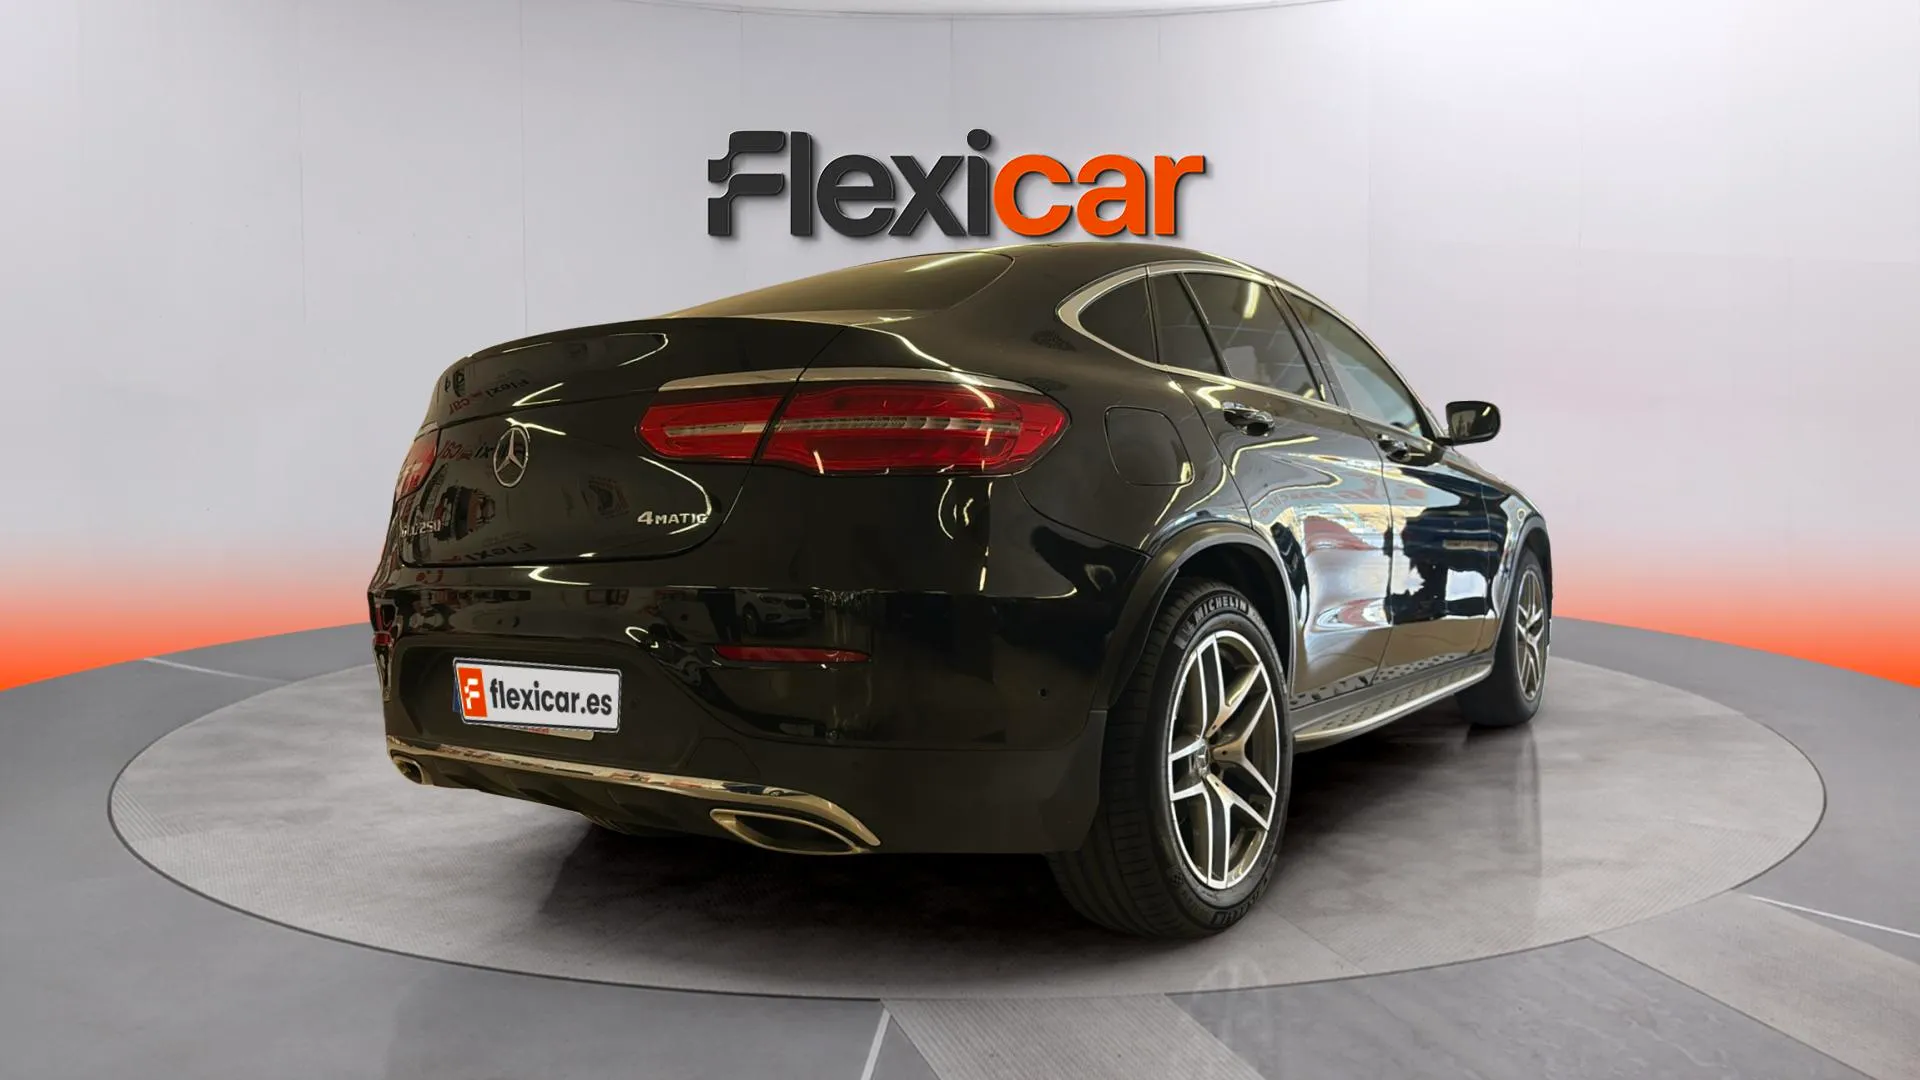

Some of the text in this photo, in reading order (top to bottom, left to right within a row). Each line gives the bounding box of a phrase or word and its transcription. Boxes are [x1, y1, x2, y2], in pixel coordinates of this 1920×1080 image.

[707, 128, 1206, 237] Flexicar
[637, 511, 708, 525] 4MATIC
[1194, 596, 1248, 623] MICHELIN
[489, 678, 613, 716] flexicar.es
